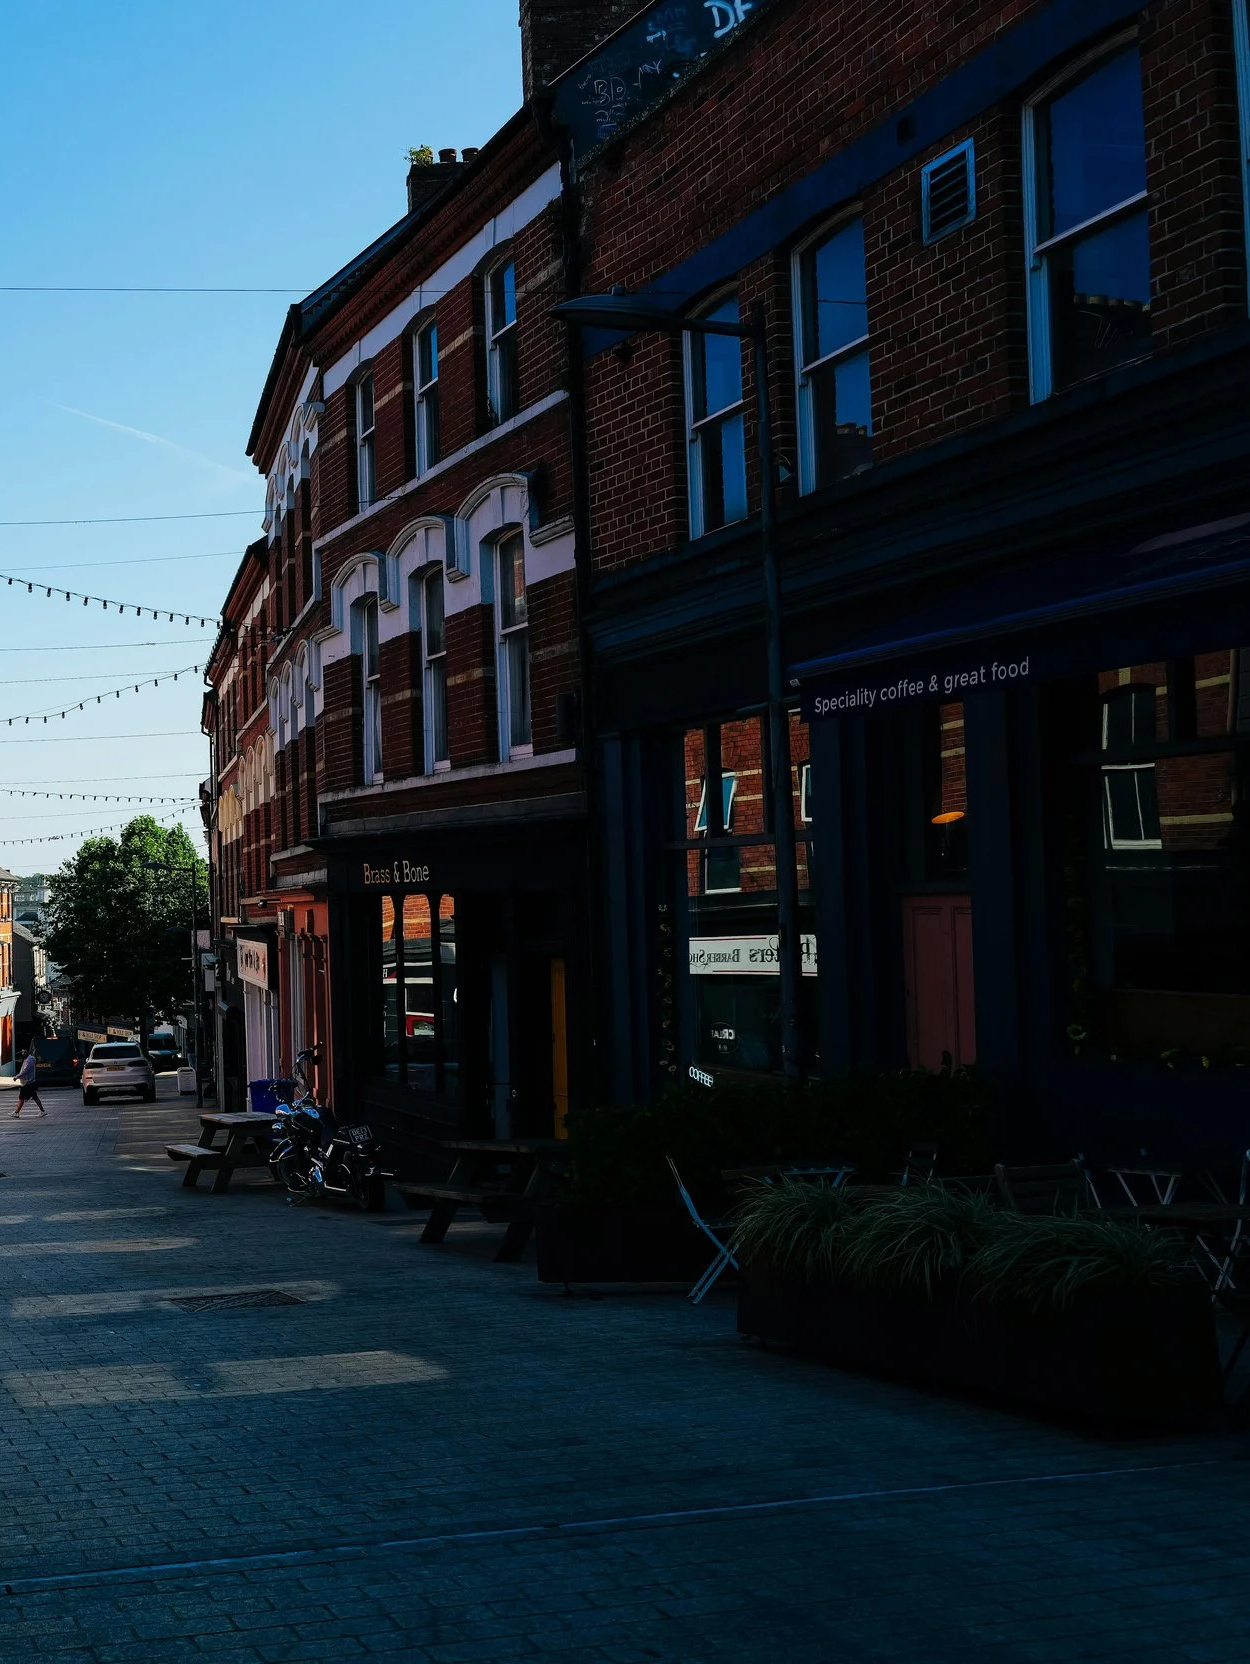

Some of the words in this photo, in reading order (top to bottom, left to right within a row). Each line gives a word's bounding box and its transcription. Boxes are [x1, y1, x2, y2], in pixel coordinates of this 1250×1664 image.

[814, 688, 877, 715] Speciality
[880, 679, 924, 701] coffee
[928, 674, 938, 692] &
[944, 666, 986, 694] great
[991, 656, 1030, 681] food
[362, 863, 391, 885] Brass
[393, 861, 400, 881] &
[402, 860, 430, 883] Bone
